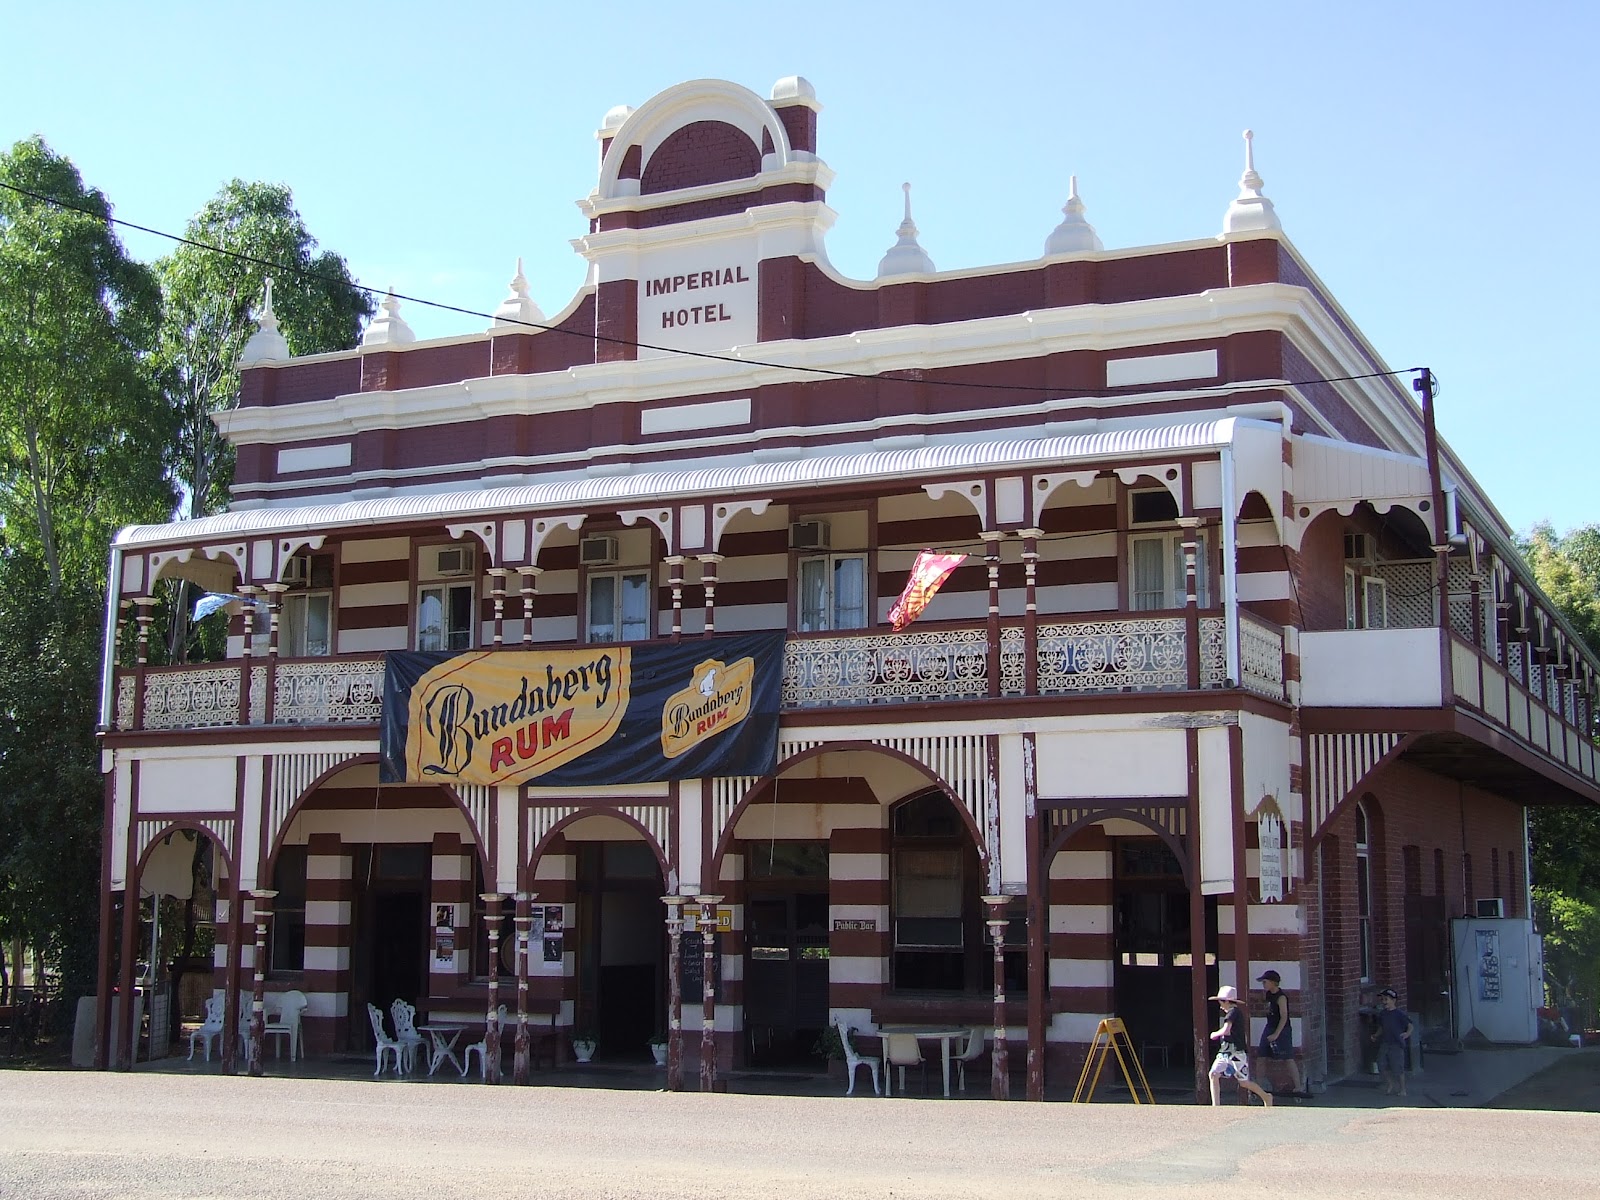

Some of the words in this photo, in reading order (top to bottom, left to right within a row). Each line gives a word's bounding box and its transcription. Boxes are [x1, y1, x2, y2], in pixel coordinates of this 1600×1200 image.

[646, 266, 749, 297] IMPERIAL
[662, 303, 731, 329] HOTEL
[422, 653, 612, 778] Bundaberg
[669, 686, 743, 739] Bundaberg
[696, 706, 729, 736] RUM
[489, 707, 575, 774] RUM
[835, 920, 858, 931] Public
[859, 920, 875, 931] Bar
